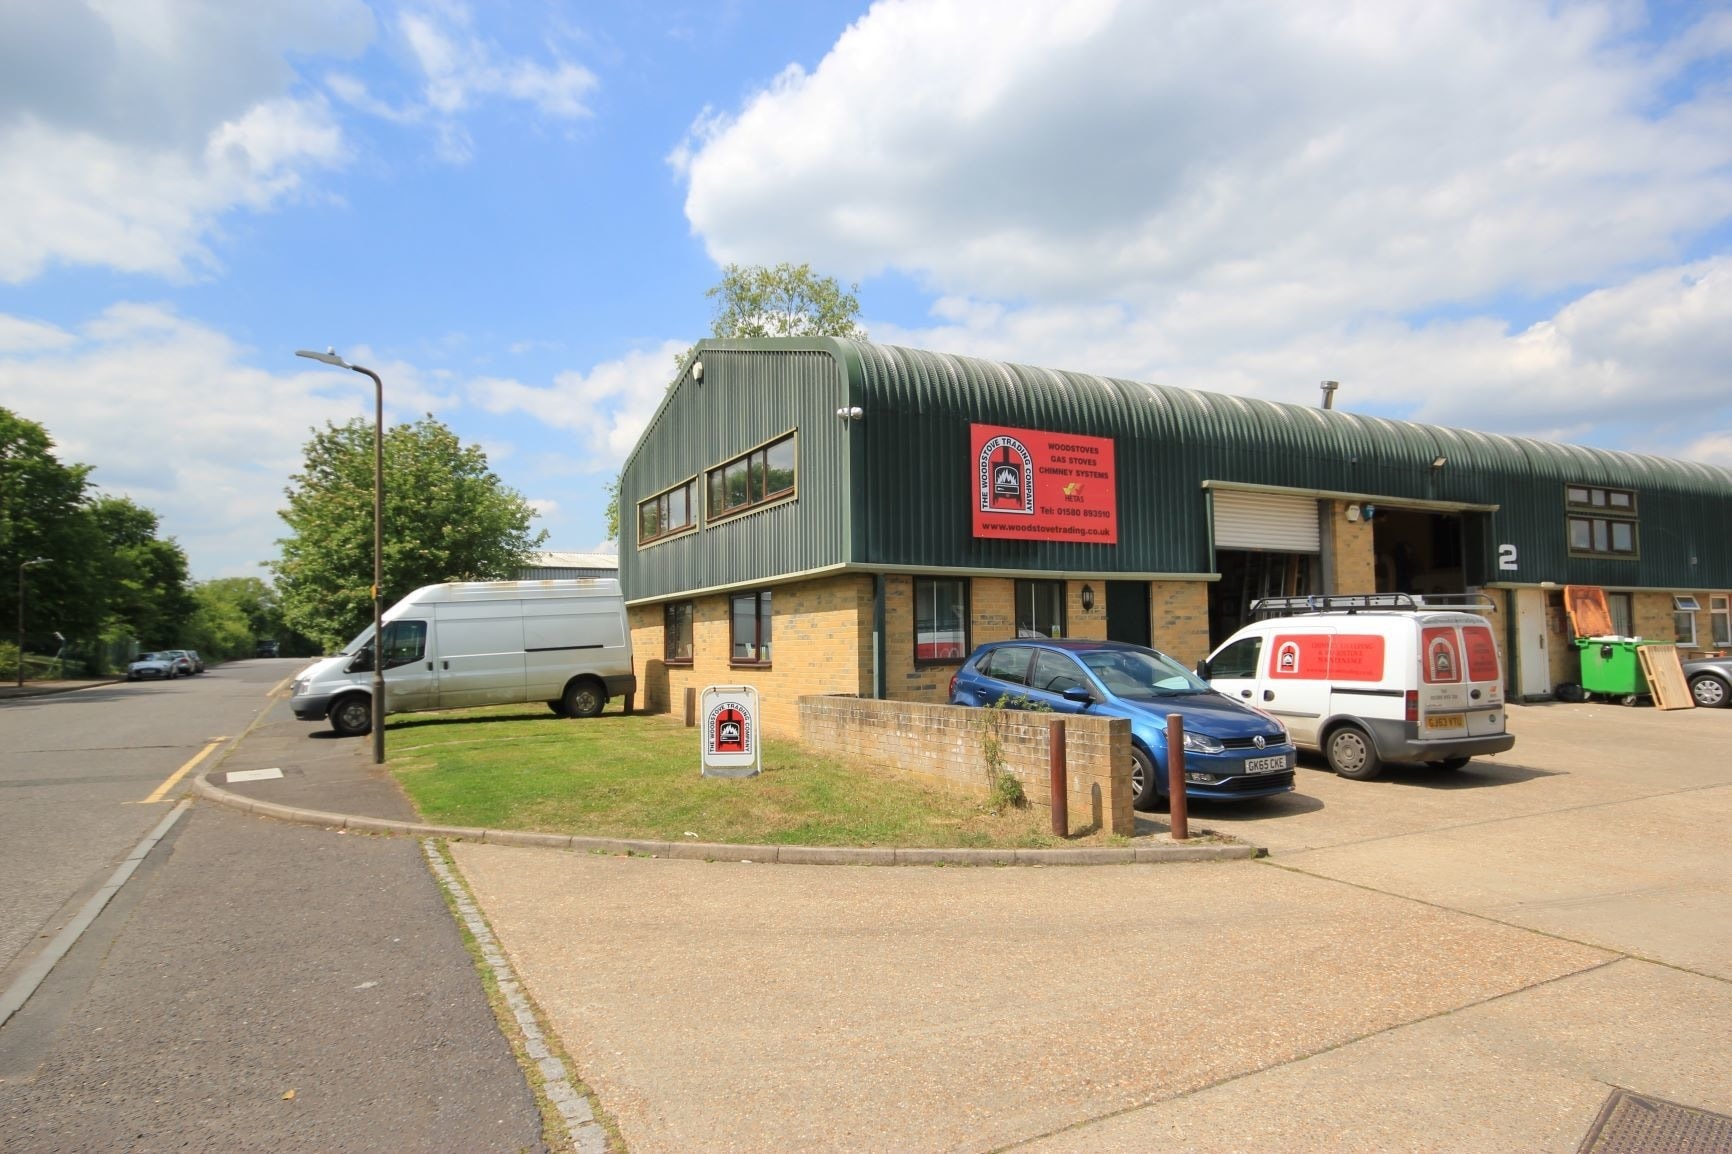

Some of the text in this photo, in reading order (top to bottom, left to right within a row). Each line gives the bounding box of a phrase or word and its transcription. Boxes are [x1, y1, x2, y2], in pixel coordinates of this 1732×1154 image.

[1048, 442, 1099, 454] WOODSTOVES
[1050, 455, 1097, 466] GAS STOVES
[981, 440, 1000, 488] WOODSTOVE
[1002, 438, 1030, 465] TRADING
[1025, 468, 1033, 512] COMPANY
[1039, 466, 1109, 479] CHIMNEY SYSTEMS
[1040, 506, 1055, 515] Tel:
[1057, 507, 1081, 517] 01580
[982, 523, 1110, 536] www.woodstovetrading.co.uk
[1498, 544, 1518, 571] 2
[710, 705, 725, 739] WOODSTOVE
[727, 704, 749, 720] TRADING
[1248, 757, 1284, 771] GK65 CKE
